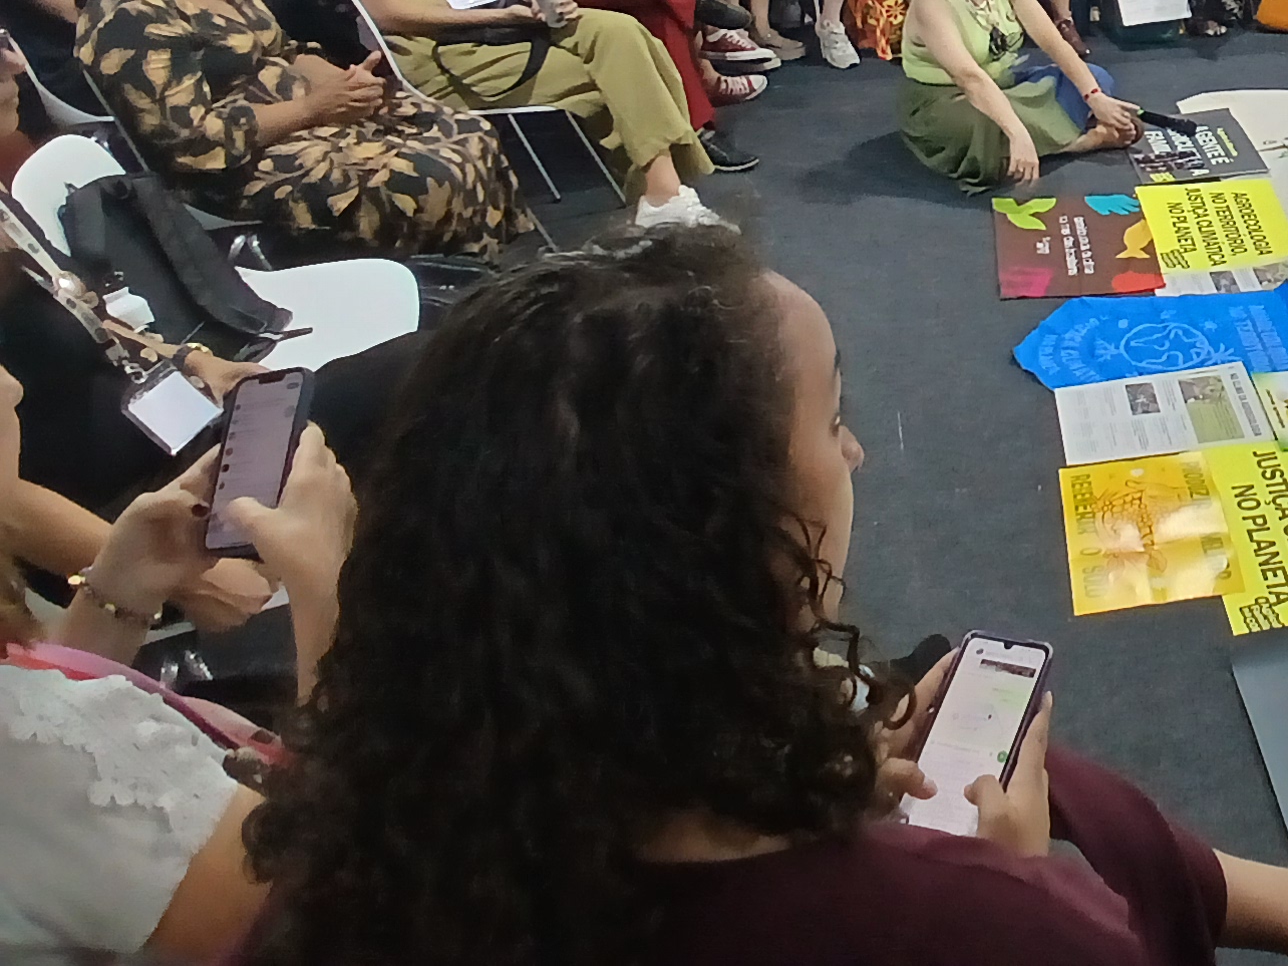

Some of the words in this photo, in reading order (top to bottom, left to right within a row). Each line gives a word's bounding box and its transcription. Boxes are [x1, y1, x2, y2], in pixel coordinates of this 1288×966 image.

[1167, 202, 1185, 215] NO
[1185, 187, 1210, 219] JUSTIÇA
[1209, 192, 1228, 205] NO
[1171, 215, 1198, 253] PLANETA
[1214, 204, 1248, 256] TERRITÓRIO,
[1231, 192, 1273, 256] AGROECOLOGIA
[1196, 220, 1227, 266] CLIMÁTICA
[1231, 484, 1261, 511] NO
